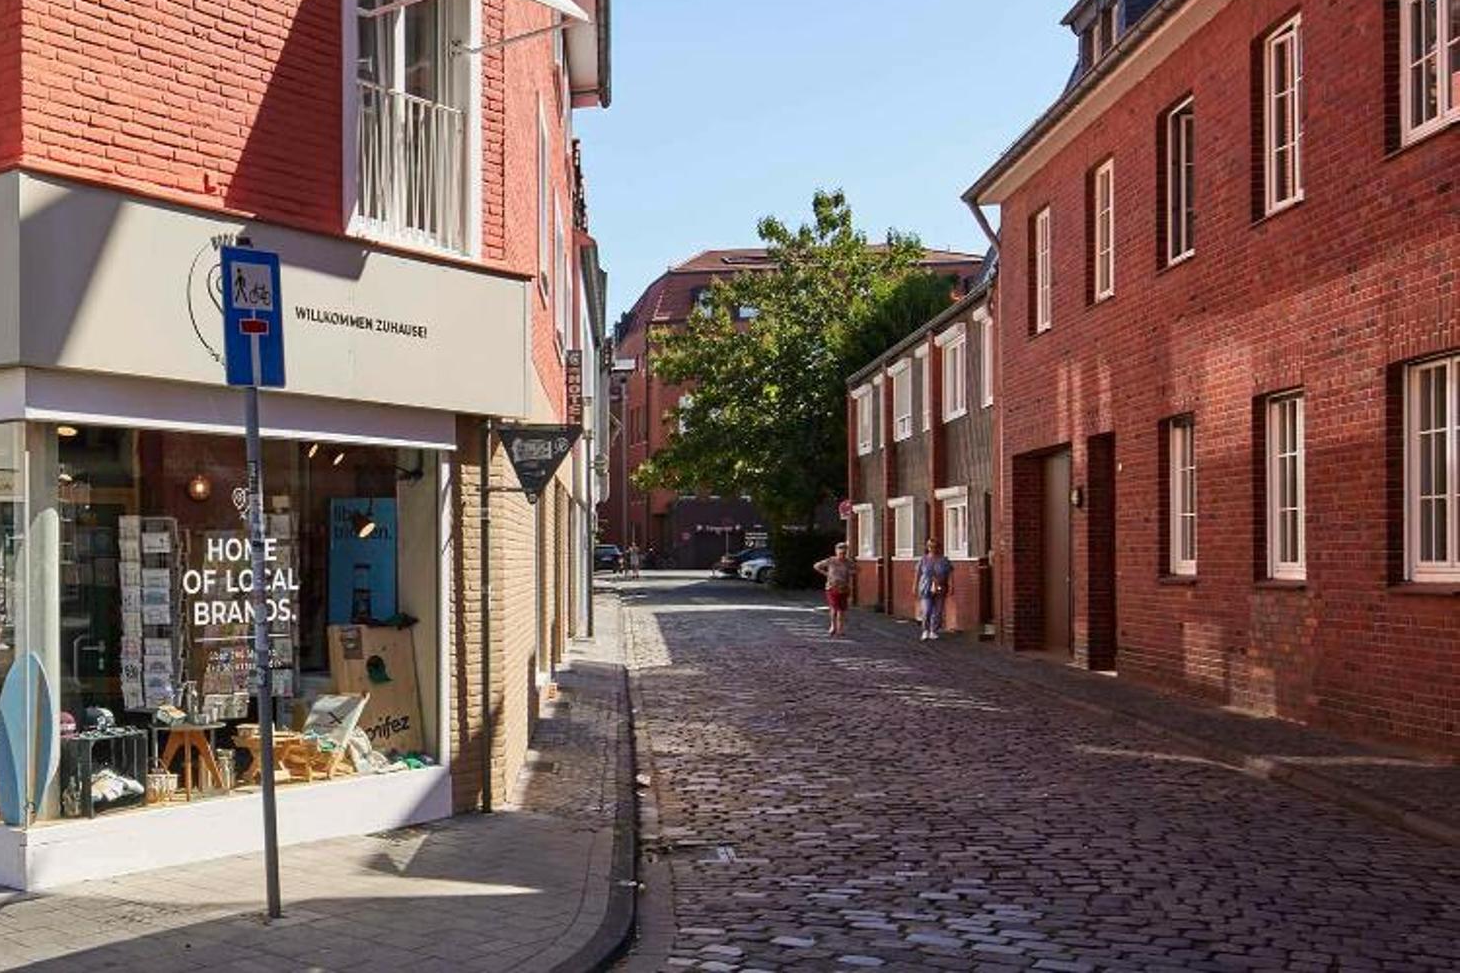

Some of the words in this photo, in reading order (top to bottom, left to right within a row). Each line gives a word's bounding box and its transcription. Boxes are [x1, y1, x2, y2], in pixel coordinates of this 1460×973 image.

[295, 306, 373, 330] WILLKOMMEN
[375, 319, 427, 339] ZUHAUSE!
[182, 569, 217, 595] OF
